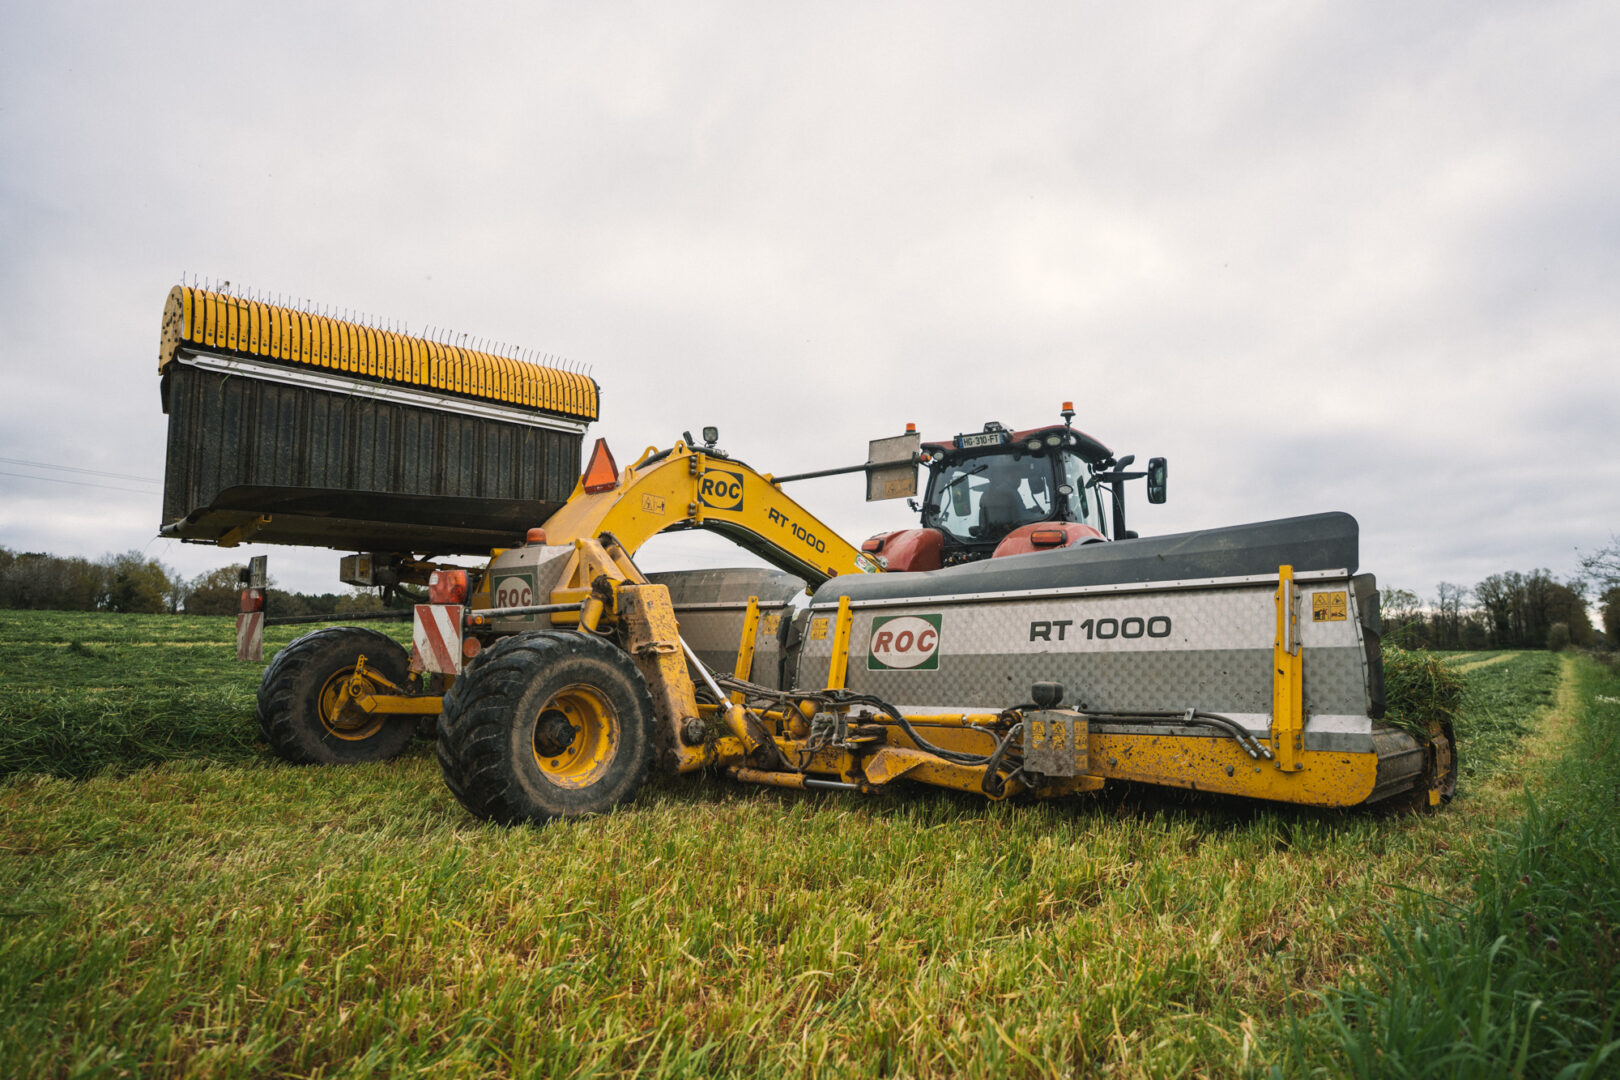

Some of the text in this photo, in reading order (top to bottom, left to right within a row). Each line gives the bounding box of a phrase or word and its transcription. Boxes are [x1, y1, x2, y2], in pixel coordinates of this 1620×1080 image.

[701, 478, 740, 499] ROC
[768, 507, 825, 553] RT 1000
[498, 588, 531, 608] ROC
[1029, 616, 1172, 641] RT 1000
[873, 629, 937, 653] ROC
